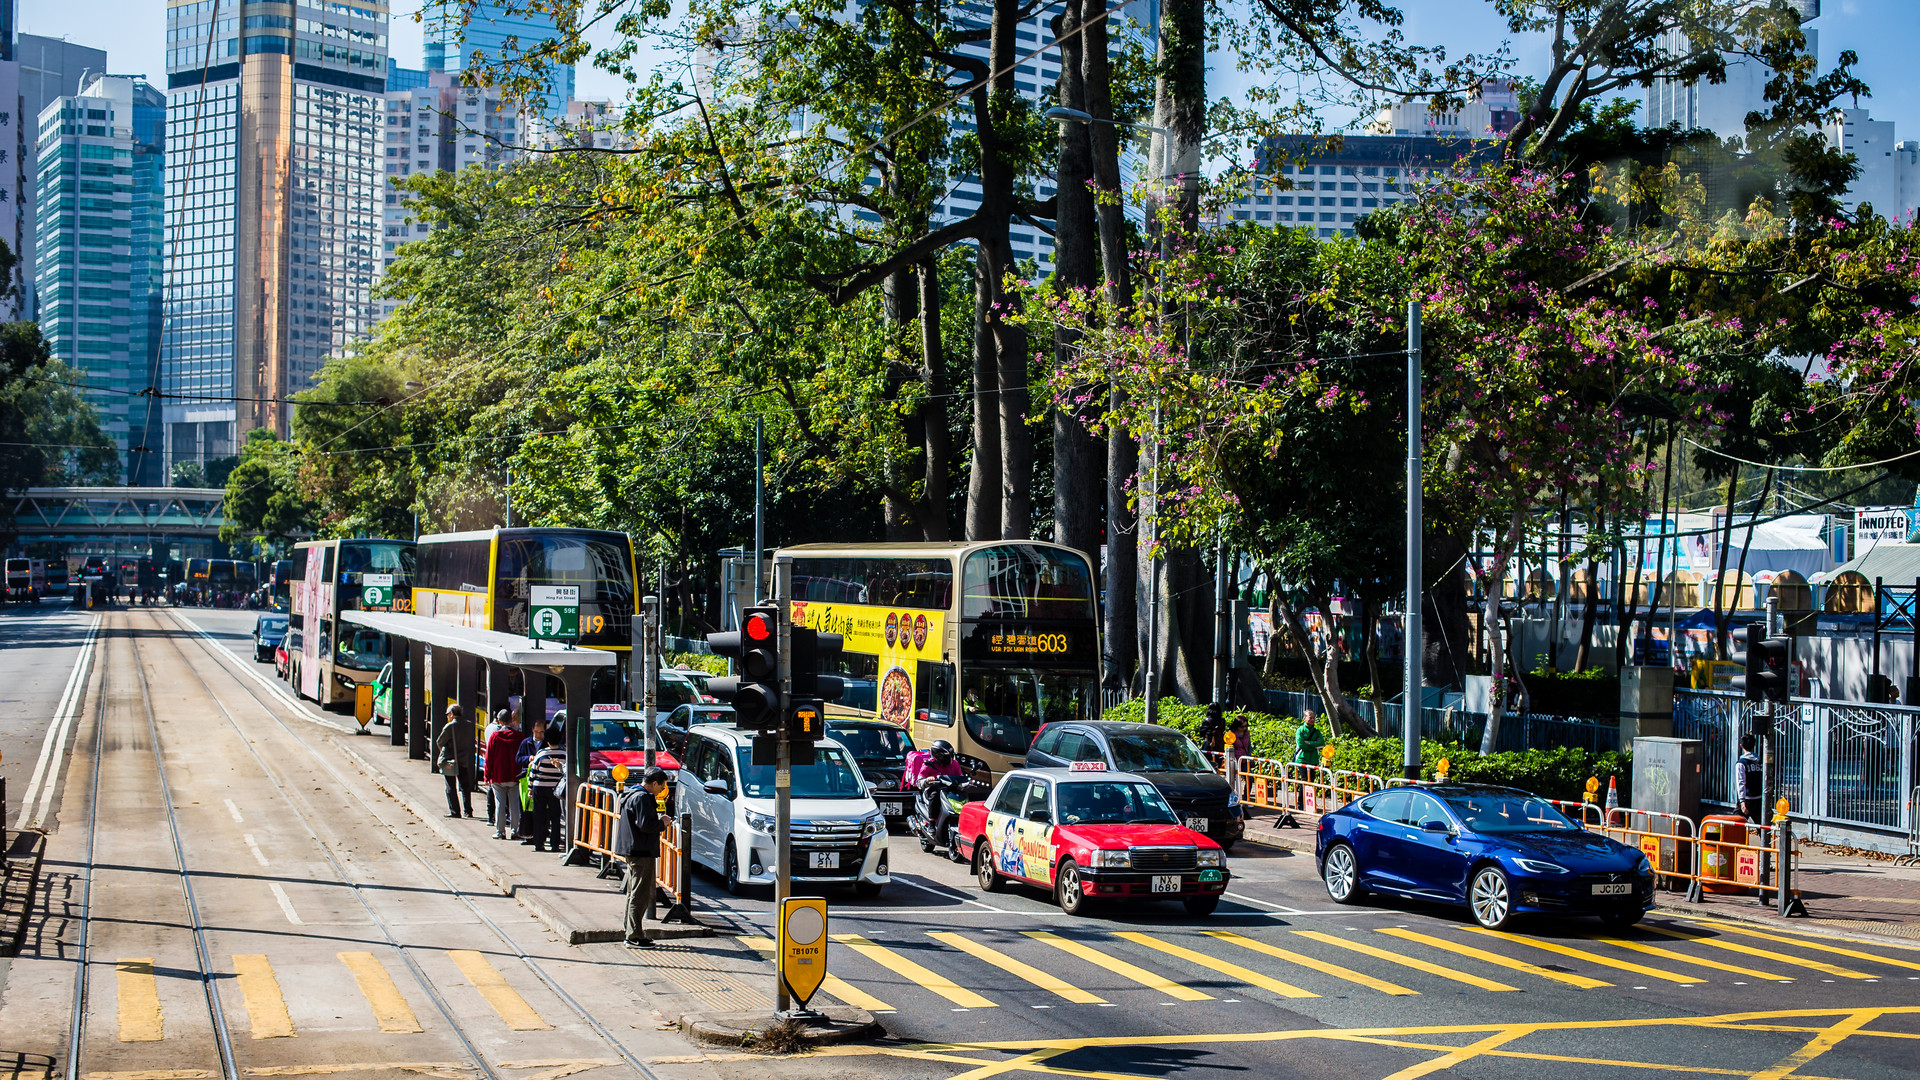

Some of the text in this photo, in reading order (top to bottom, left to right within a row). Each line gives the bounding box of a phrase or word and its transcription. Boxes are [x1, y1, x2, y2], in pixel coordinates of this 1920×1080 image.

[391, 598, 411, 611] 102
[1037, 633, 1067, 653] 603
[1074, 762, 1104, 770] TAXI
[1189, 824, 1205, 832] 6100
[818, 852, 831, 861] CX
[817, 860, 832, 868] 211
[1160, 876, 1173, 884] NX
[1154, 883, 1178, 891] 1689
[1600, 884, 1626, 893] JC 120
